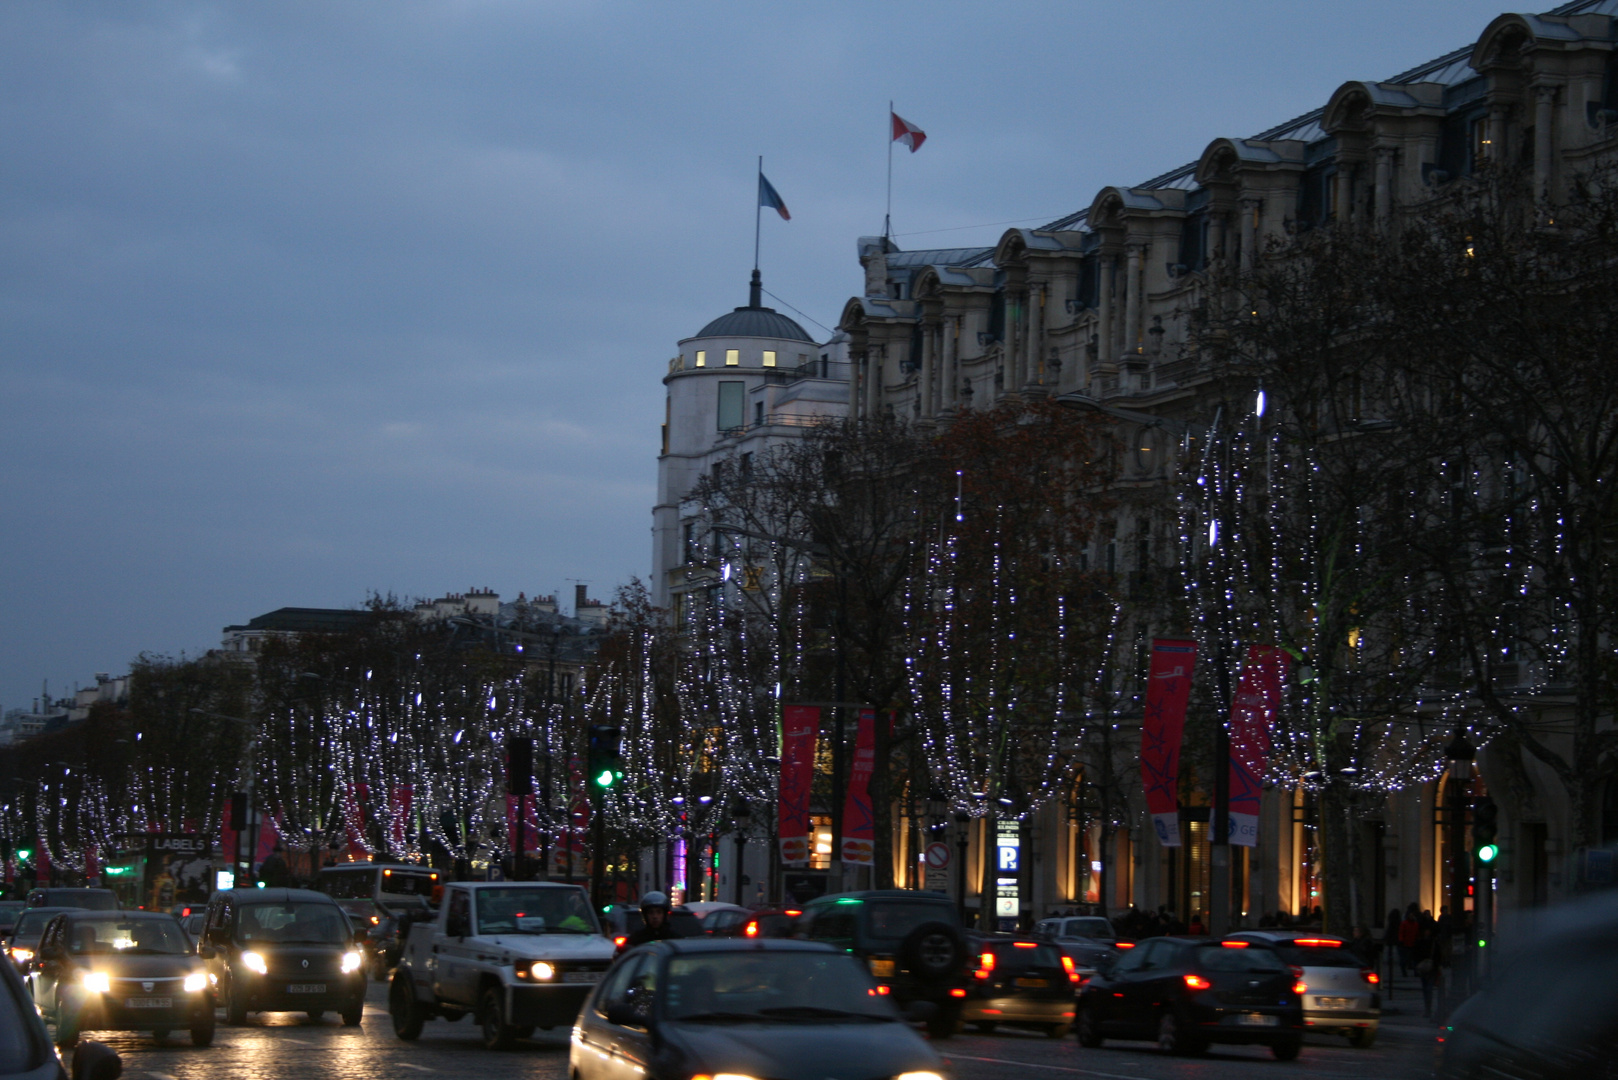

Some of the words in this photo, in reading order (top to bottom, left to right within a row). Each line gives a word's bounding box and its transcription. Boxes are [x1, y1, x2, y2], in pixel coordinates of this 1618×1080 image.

[1240, 825, 1255, 836] GE
[1000, 847, 1017, 869] P
[491, 868, 501, 880] P
